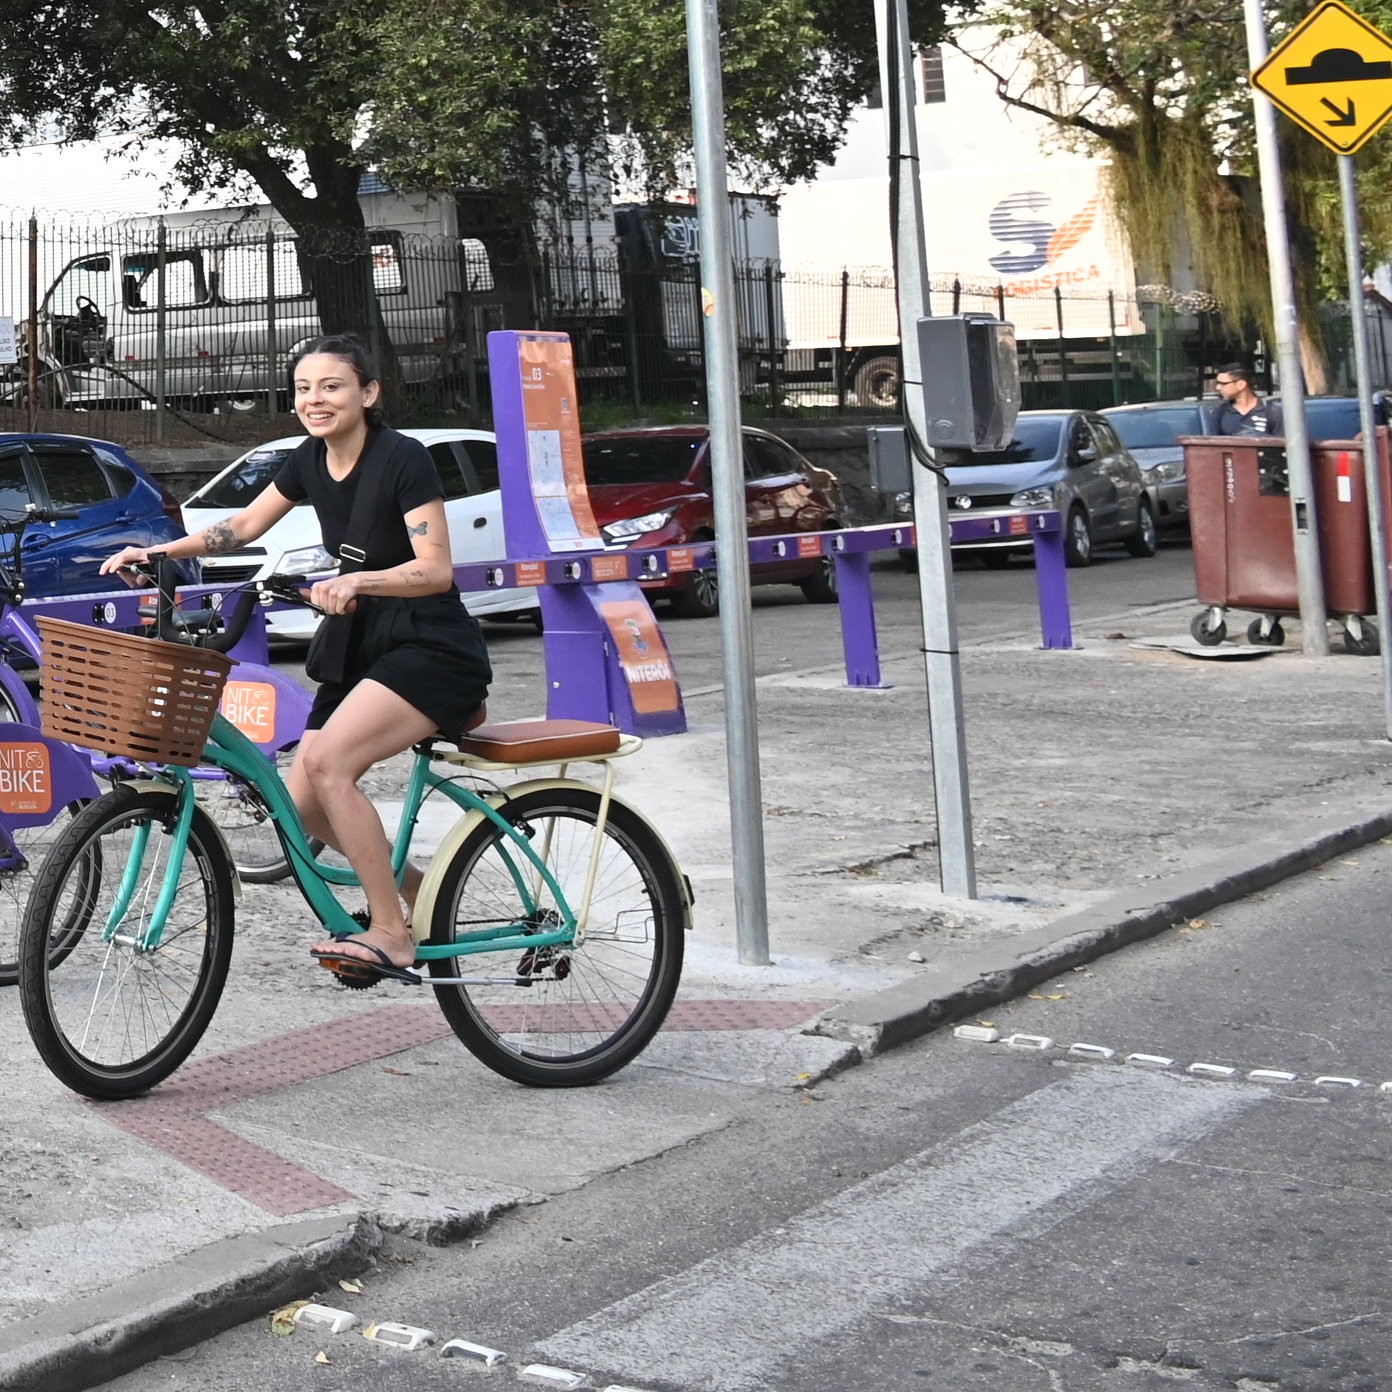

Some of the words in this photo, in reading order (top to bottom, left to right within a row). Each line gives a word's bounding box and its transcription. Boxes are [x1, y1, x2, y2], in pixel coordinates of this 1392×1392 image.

[106, 608, 115, 618] 03
[227, 688, 253, 705] NIT
[226, 704, 268, 726] BIKE
[0, 770, 45, 792] BIKE
